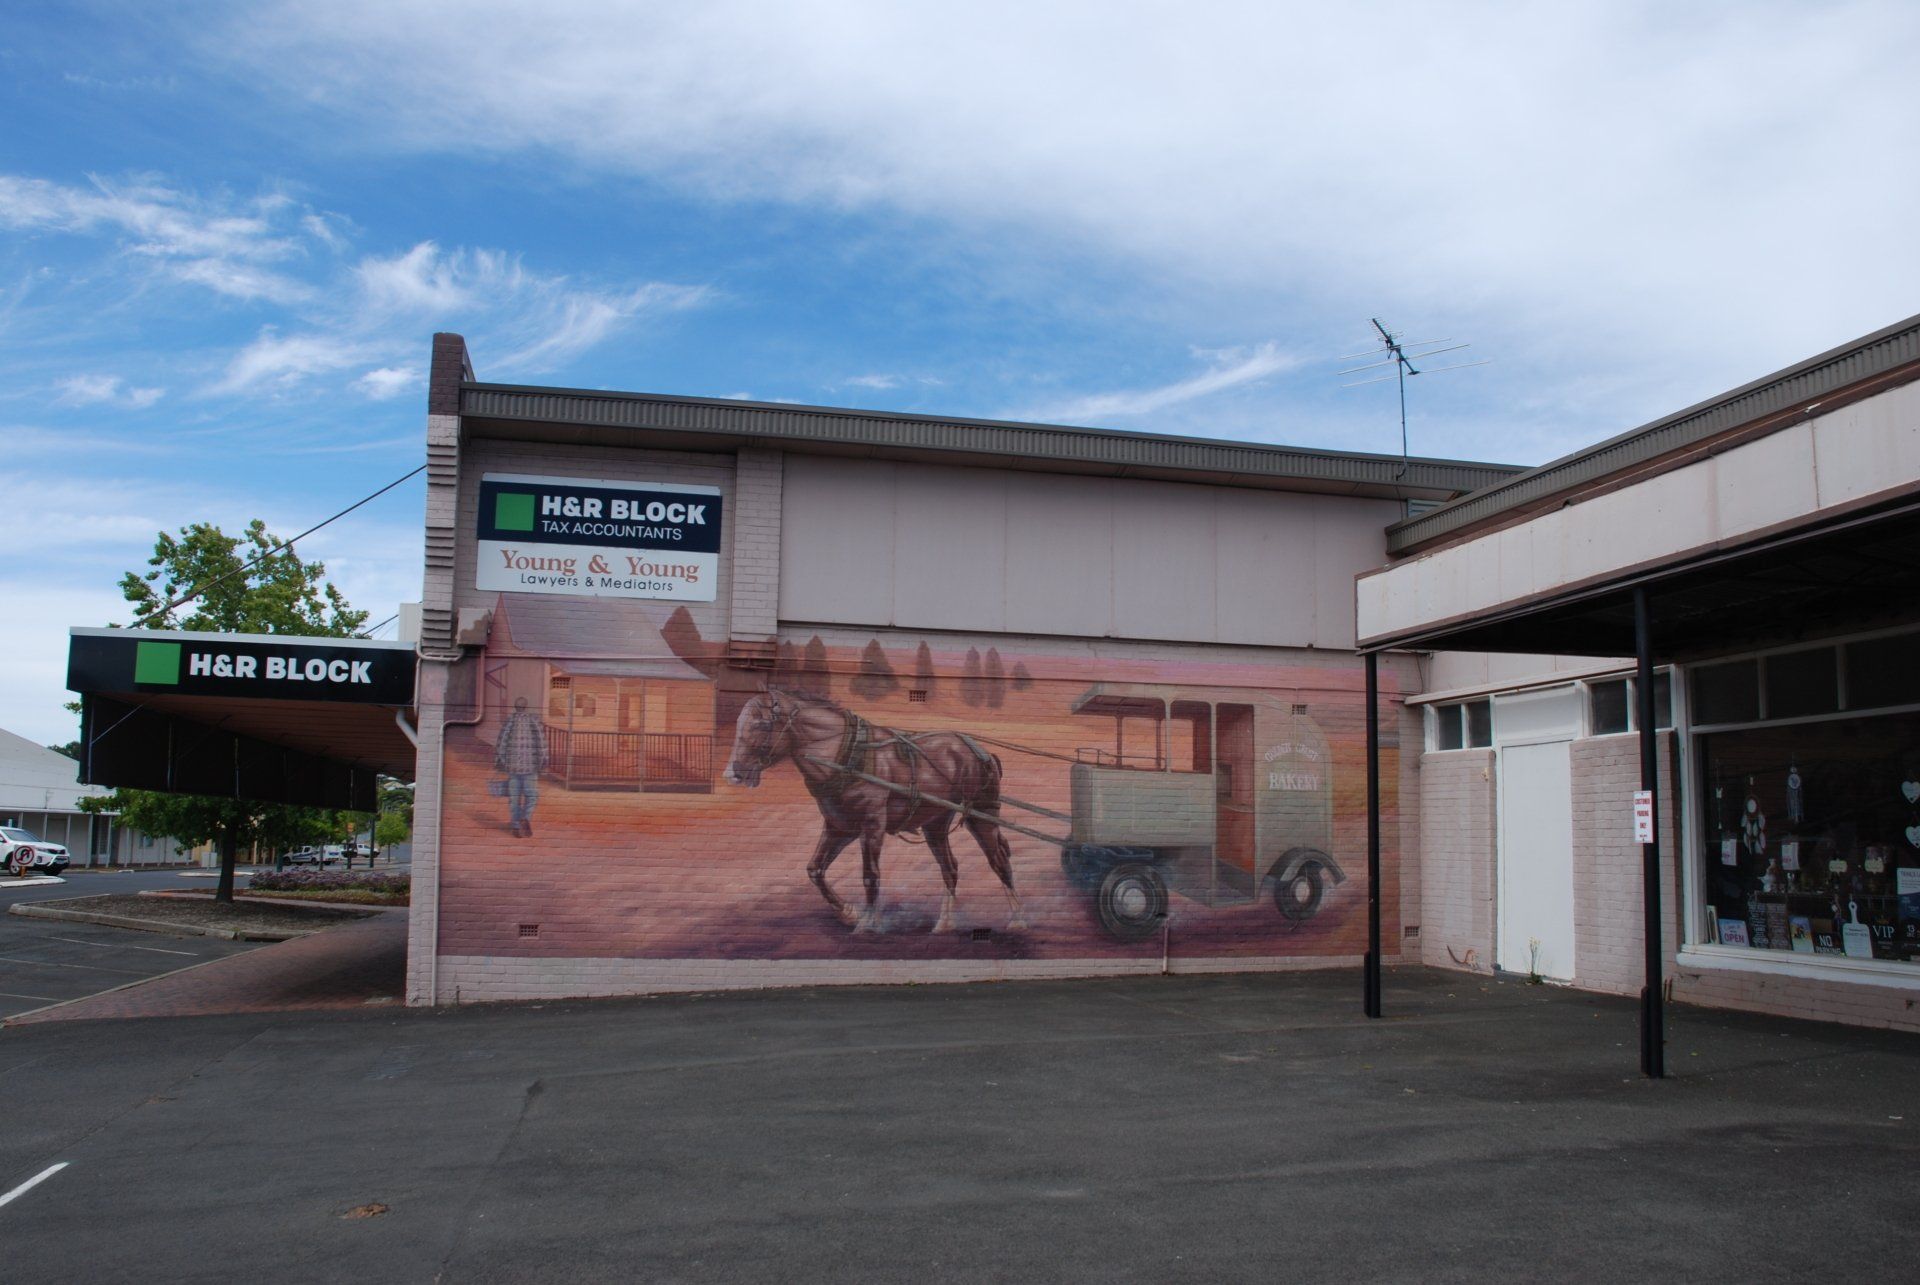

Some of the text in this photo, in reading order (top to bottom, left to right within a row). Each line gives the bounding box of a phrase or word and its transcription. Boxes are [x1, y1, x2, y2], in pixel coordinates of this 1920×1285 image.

[541, 495, 706, 525] H&R BLOCK
[541, 520, 682, 540] TAX ACCOUNTANTS
[500, 549, 700, 583] Young & Young
[520, 573, 674, 592] Lawyers & Mediators
[189, 652, 373, 684] H&R BLOCK
[1269, 772, 1318, 790] BAKERY
[1724, 933, 1745, 944] OPEN
[1818, 934, 1833, 947] NO
[1872, 925, 1895, 939] VIP
